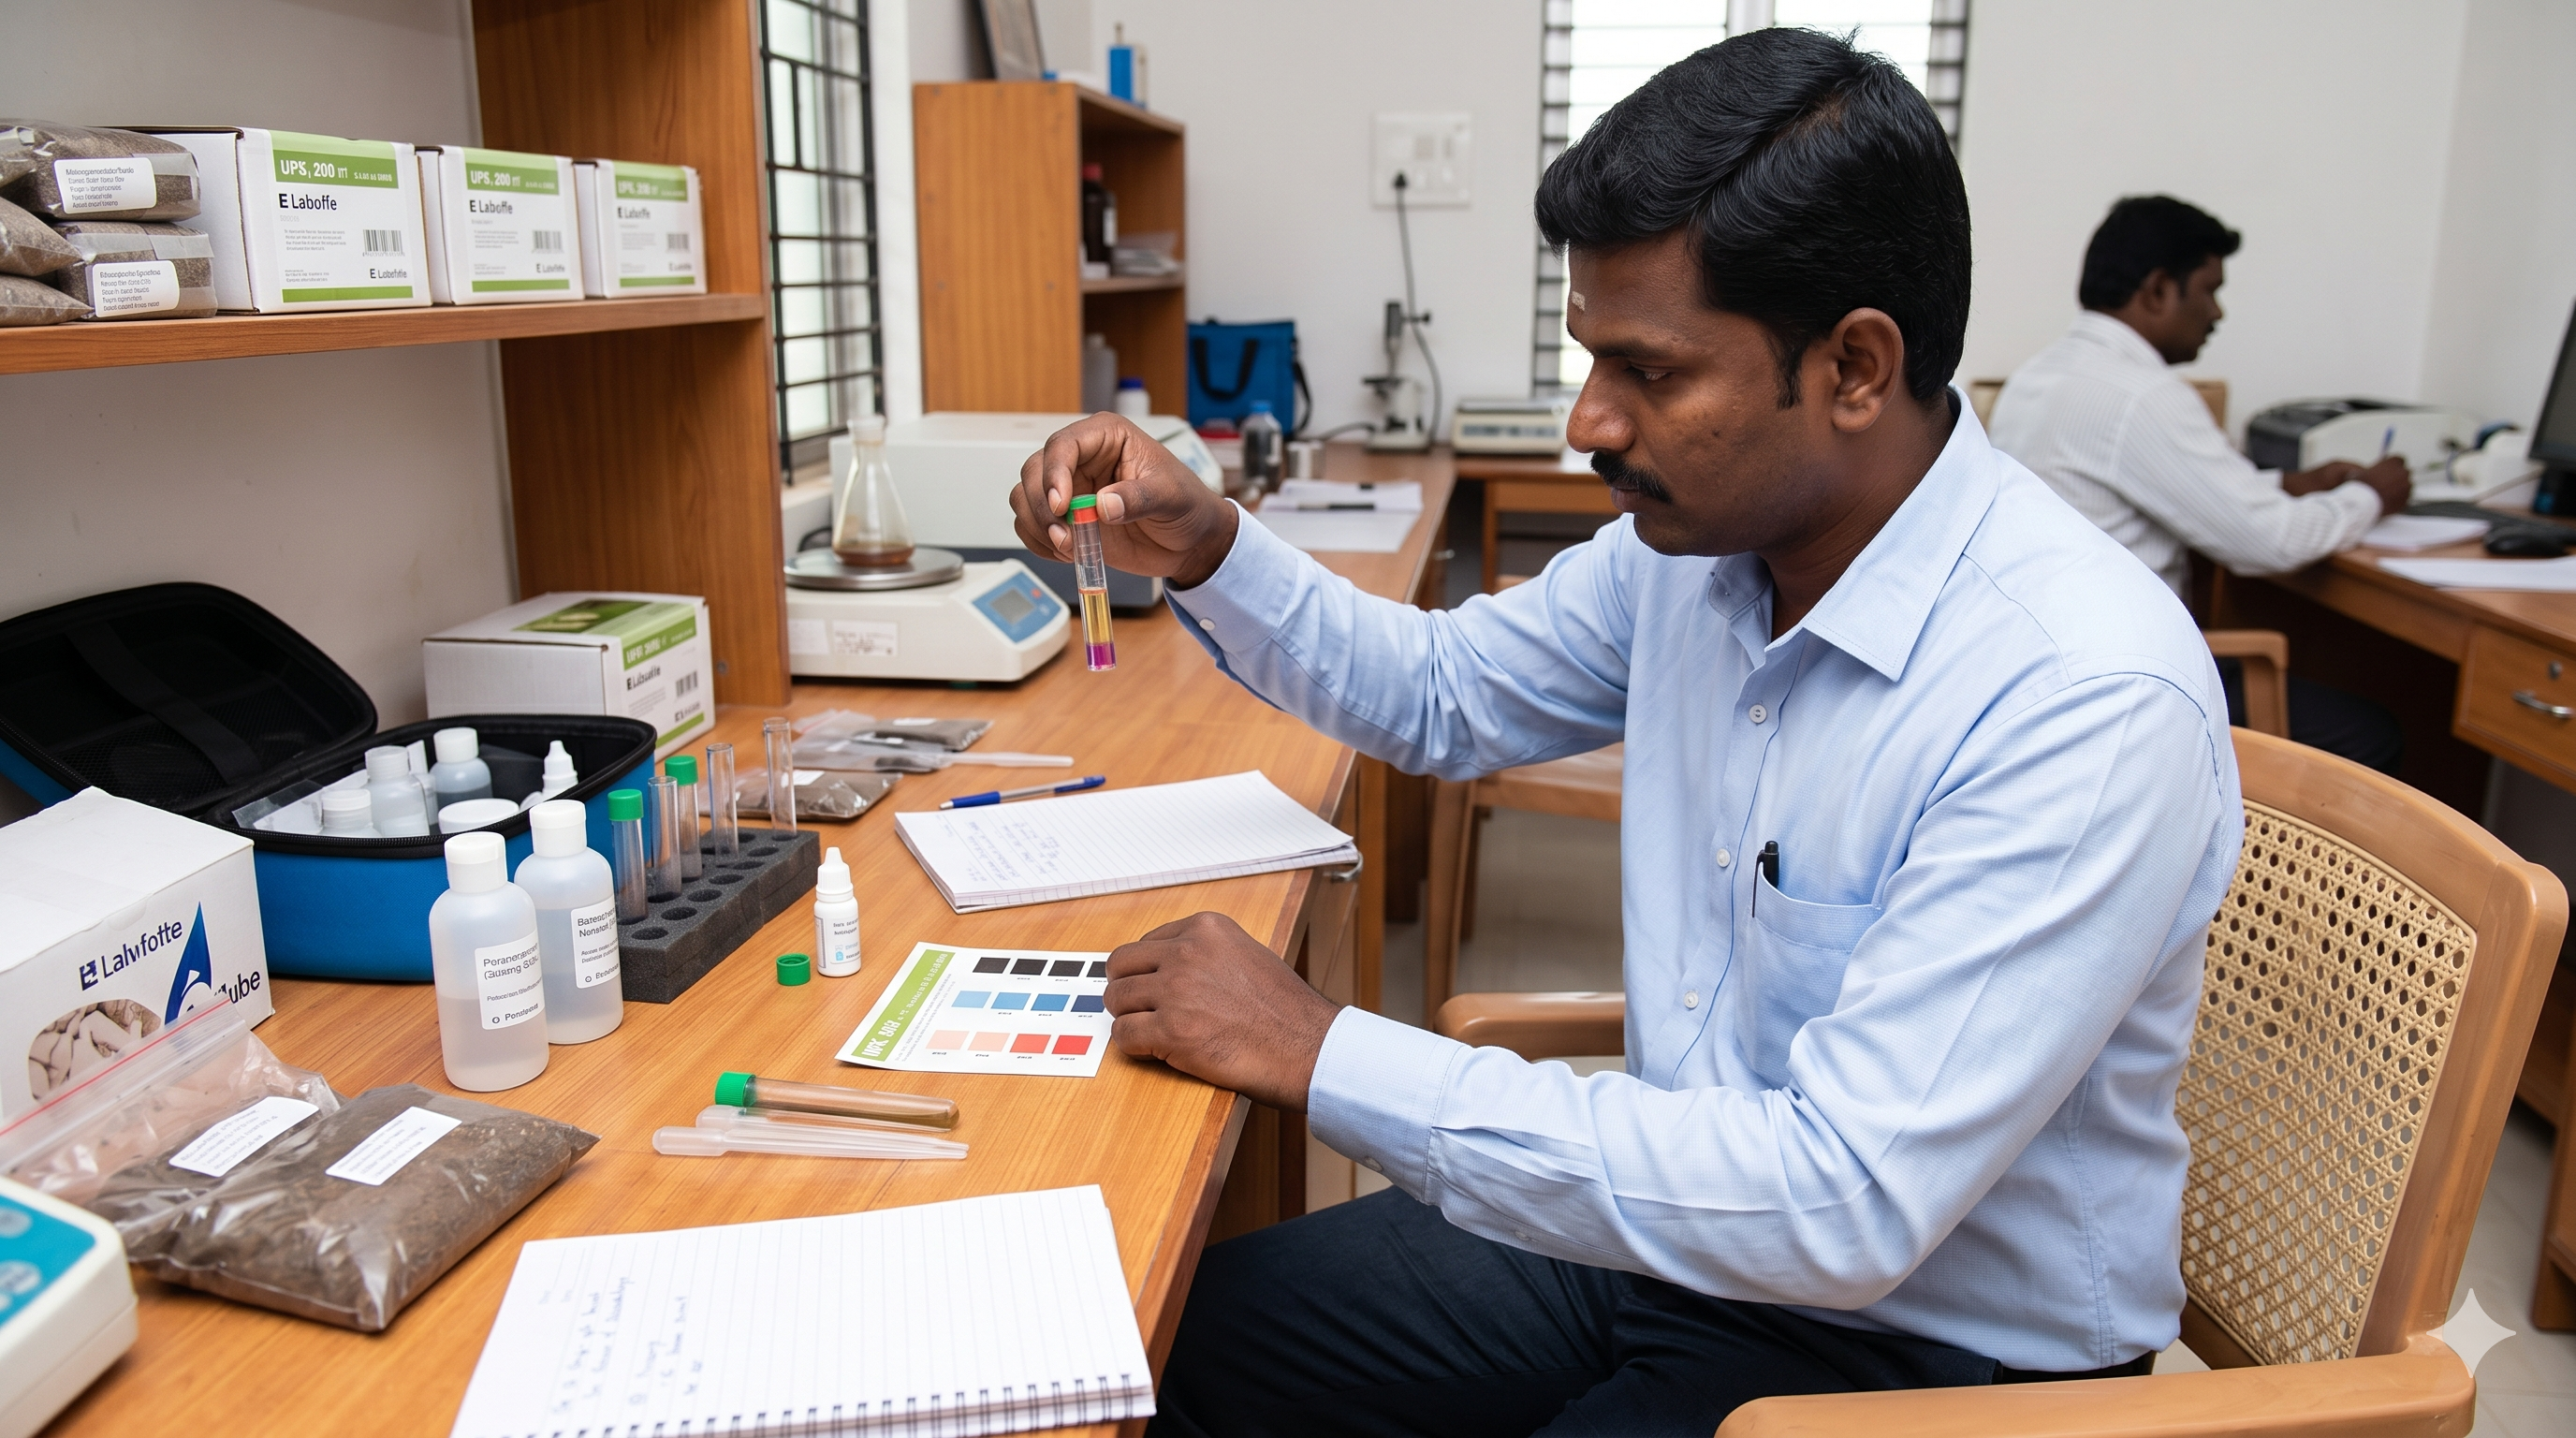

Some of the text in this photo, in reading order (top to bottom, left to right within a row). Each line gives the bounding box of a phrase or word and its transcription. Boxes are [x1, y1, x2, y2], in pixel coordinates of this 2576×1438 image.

[313, 162, 335, 178] 200
[494, 172, 511, 186] 200
[279, 193, 337, 211] E Laboffe
[469, 199, 476, 213] E
[370, 268, 376, 279] E
